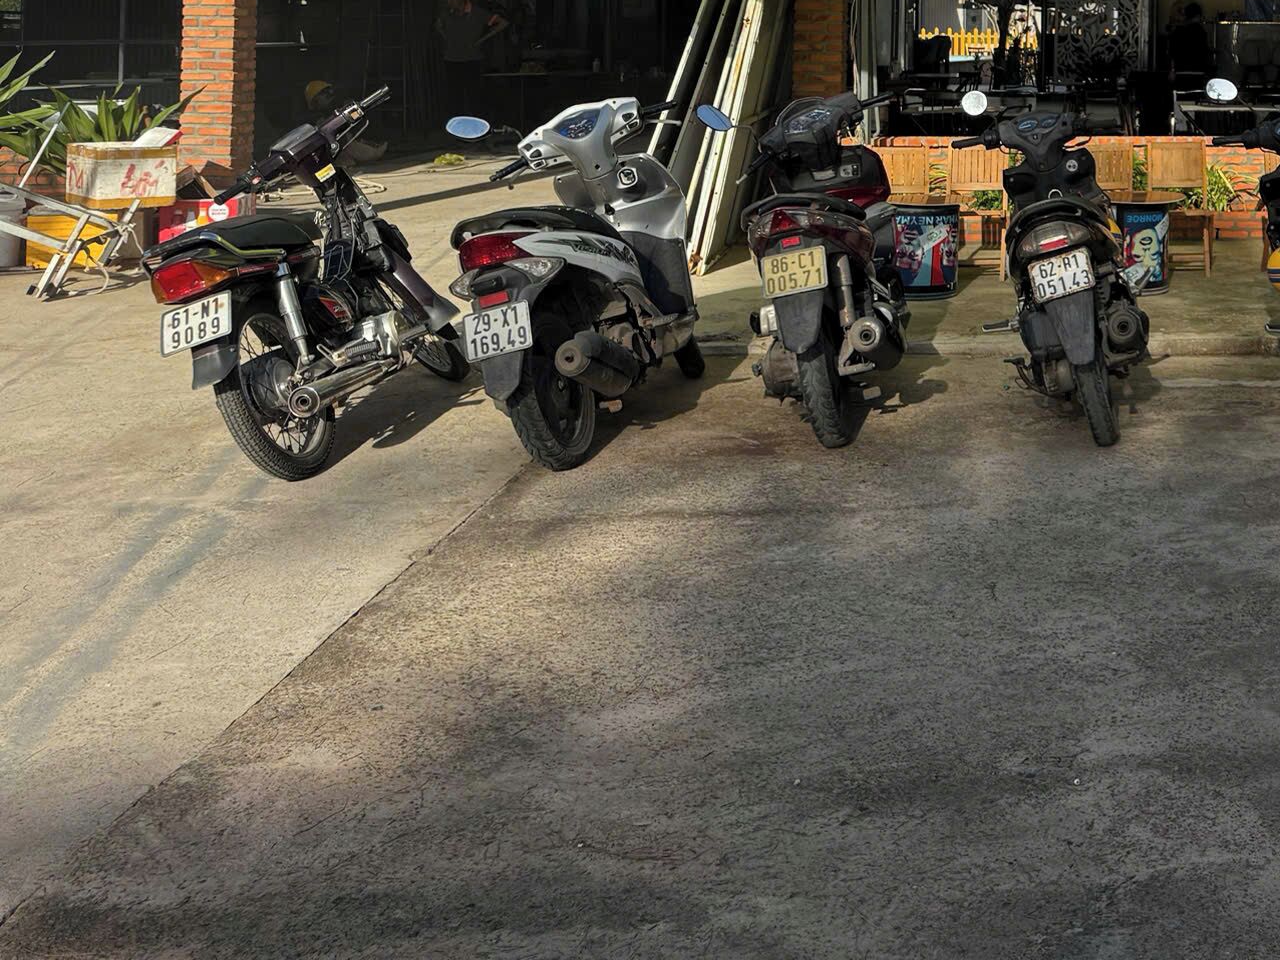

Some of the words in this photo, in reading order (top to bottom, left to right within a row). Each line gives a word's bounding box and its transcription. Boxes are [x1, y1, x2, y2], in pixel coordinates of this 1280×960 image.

[771, 251, 815, 275] 86-C1
[1039, 254, 1080, 279] 62-R1
[767, 268, 822, 294] 005.71
[1037, 269, 1090, 299] 051.43
[171, 297, 219, 330] 61-N1
[472, 306, 519, 336] 29-X1
[172, 317, 220, 349] 9089
[470, 326, 528, 358] 169.49
